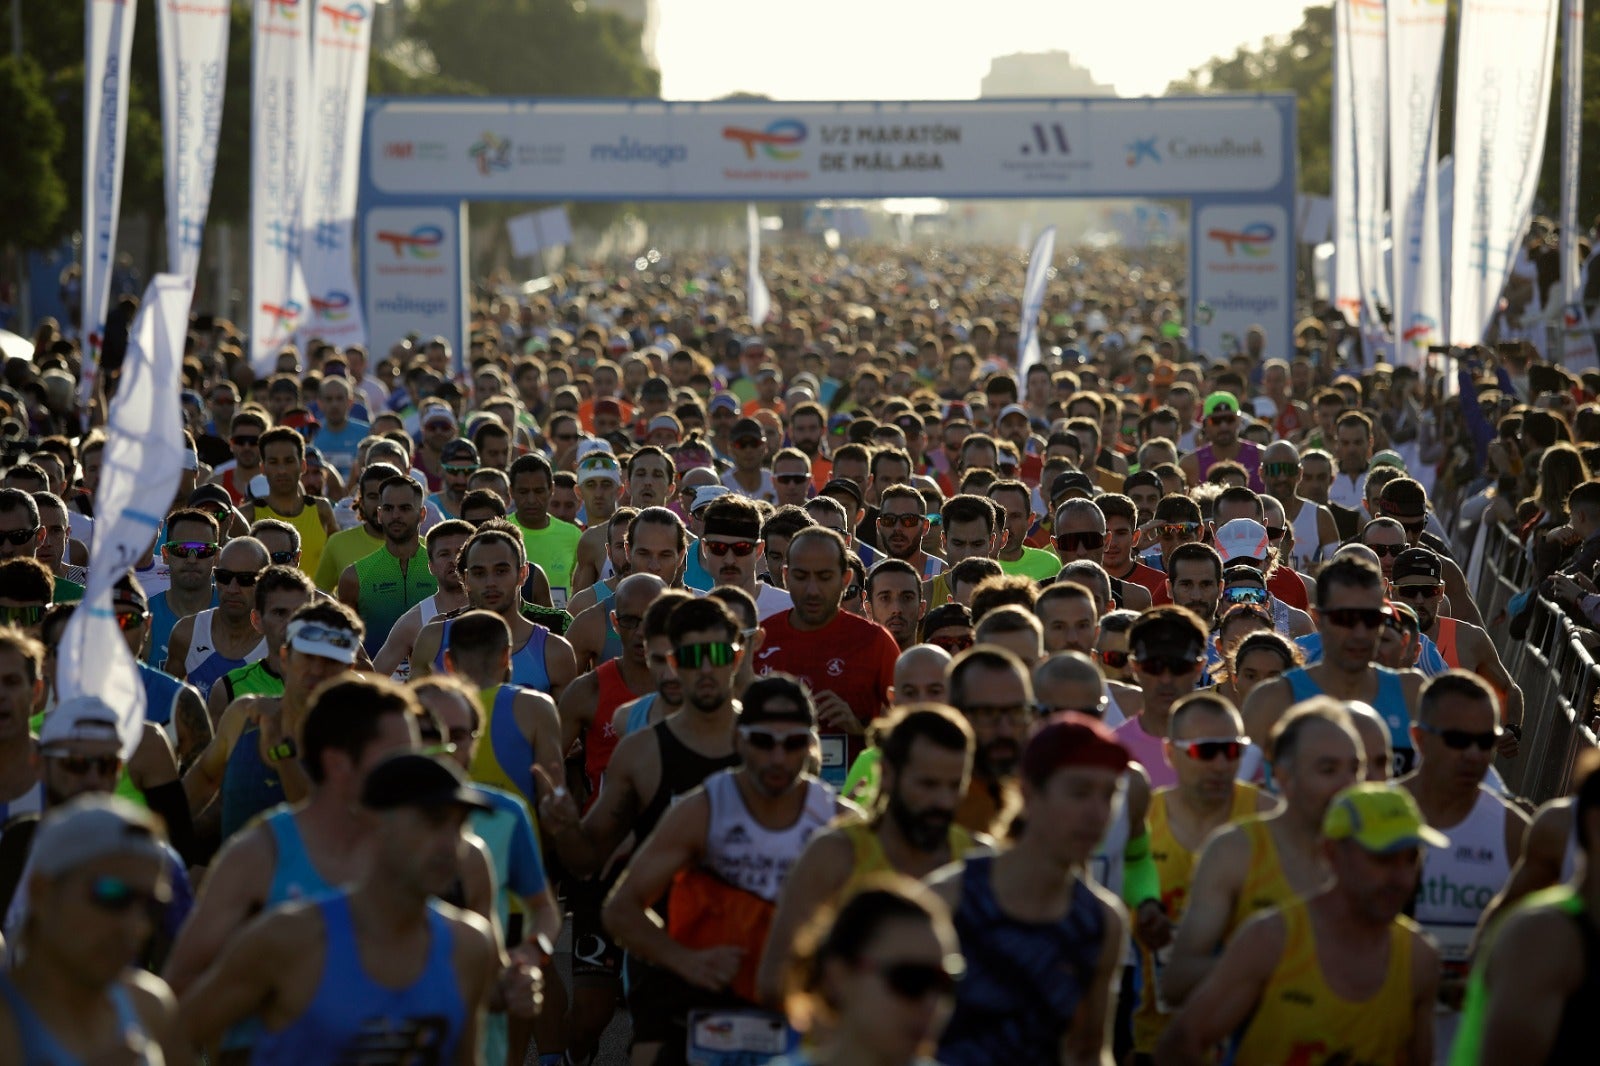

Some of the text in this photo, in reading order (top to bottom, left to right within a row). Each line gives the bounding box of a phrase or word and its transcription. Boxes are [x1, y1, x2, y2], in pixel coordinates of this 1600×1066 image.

[820, 123, 962, 145] 1/2 MARATÓN
[820, 149, 945, 171] DE MÁLAGA
